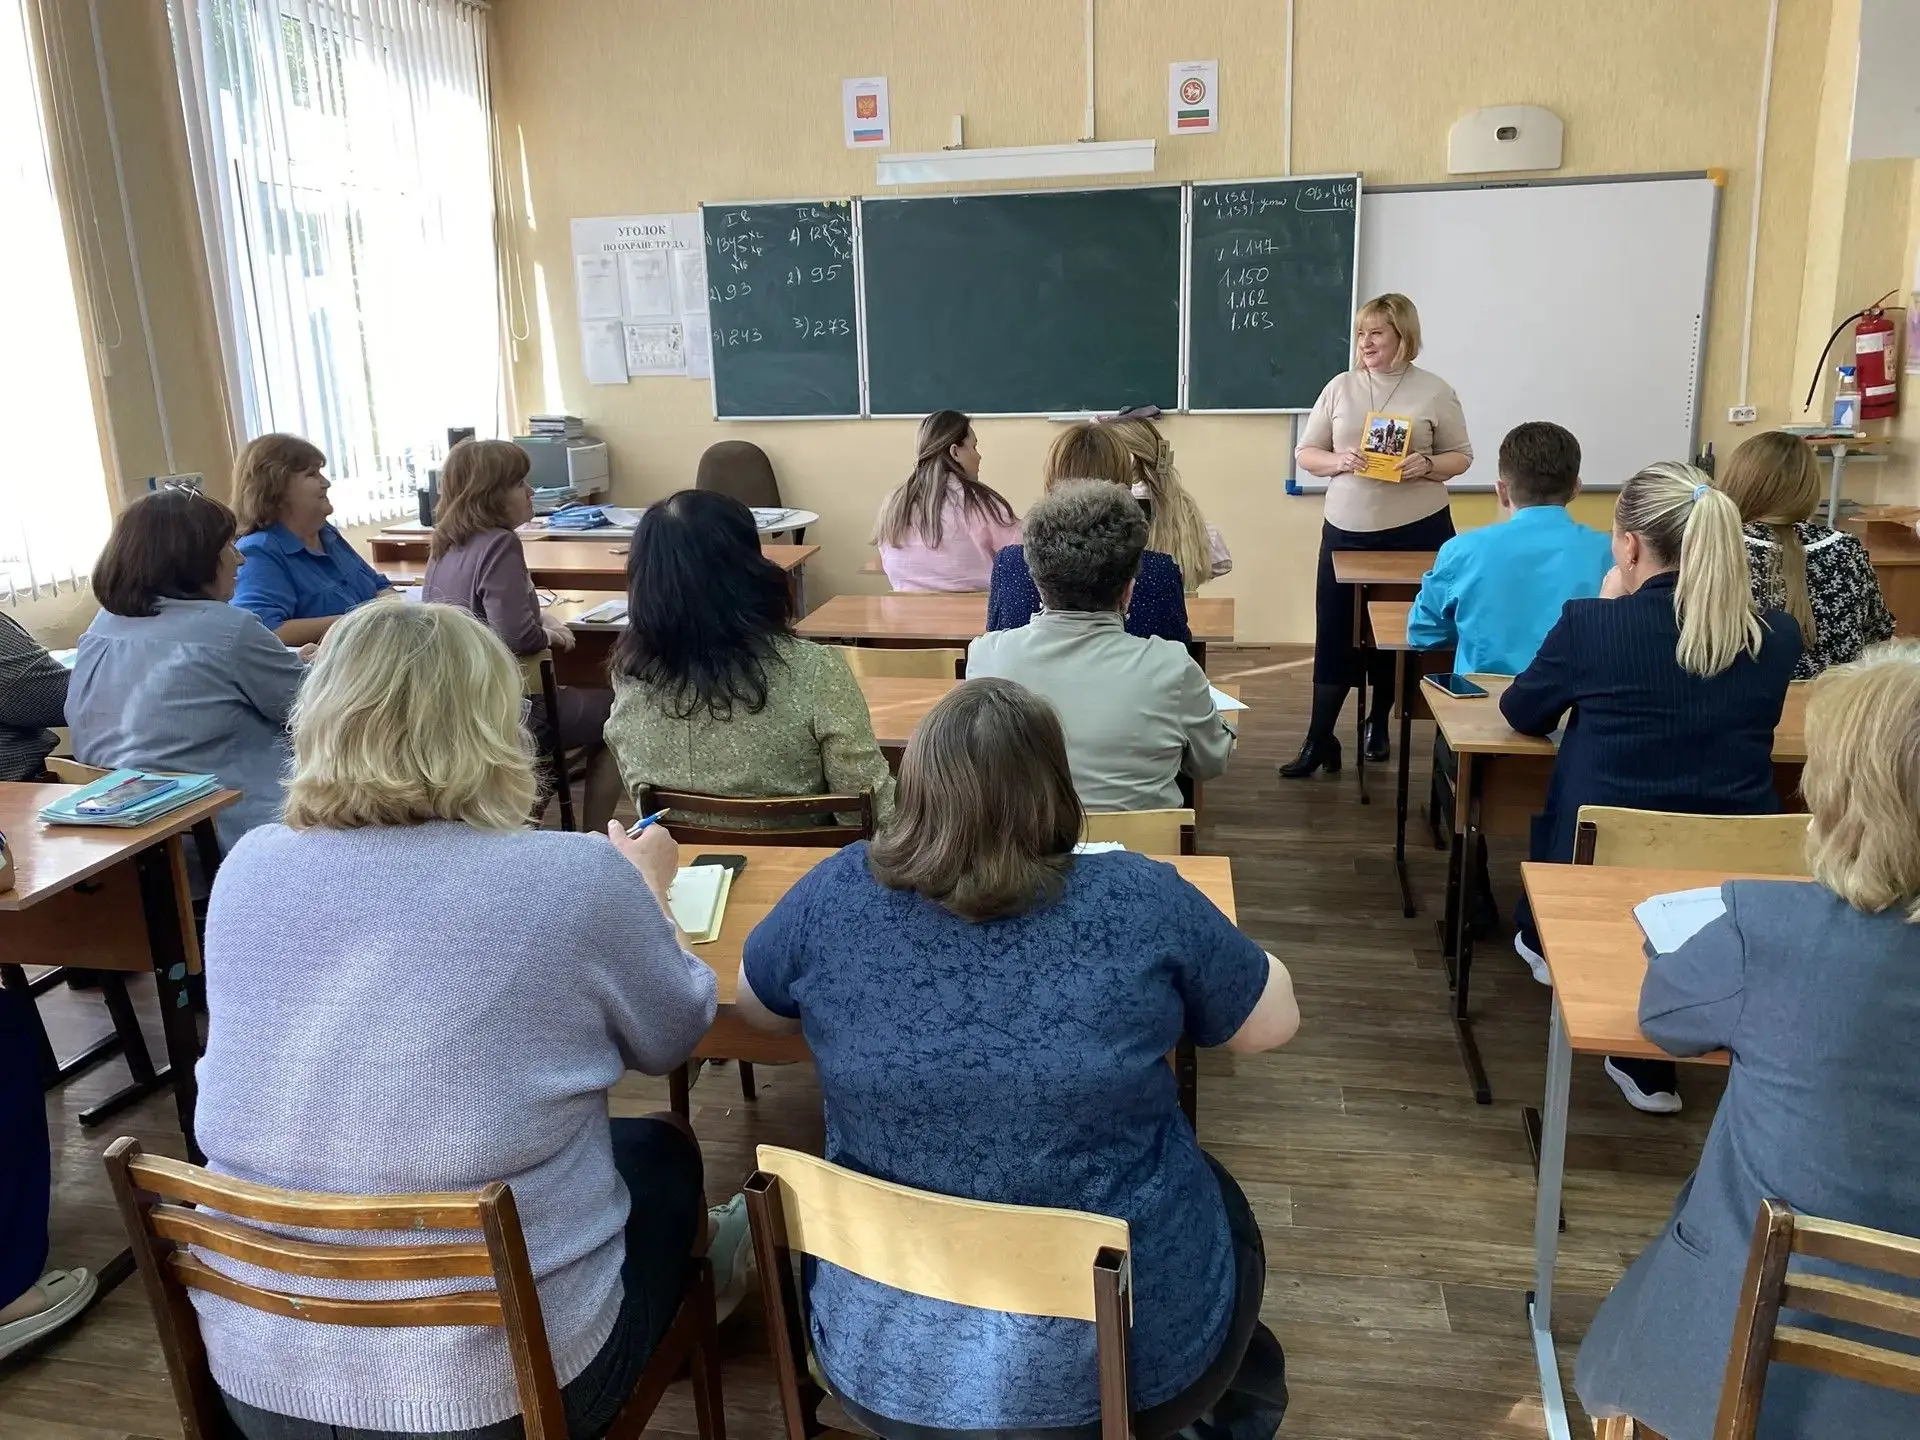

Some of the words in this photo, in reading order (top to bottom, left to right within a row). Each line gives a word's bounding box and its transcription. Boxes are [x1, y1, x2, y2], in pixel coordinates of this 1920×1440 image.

[618, 224, 667, 236] УГОЛОК
[603, 243, 617, 251] ПО
[618, 241, 652, 251] ОХРАНЕ
[655, 240, 685, 249] ТРУДА
[811, 264, 842, 283] 95
[1218, 267, 1270, 287] 1.150
[724, 282, 752, 300] 93
[1226, 288, 1269, 310] 1.162
[813, 318, 850, 337] 273
[1231, 311, 1274, 331] 1.163
[729, 327, 763, 345] 243
